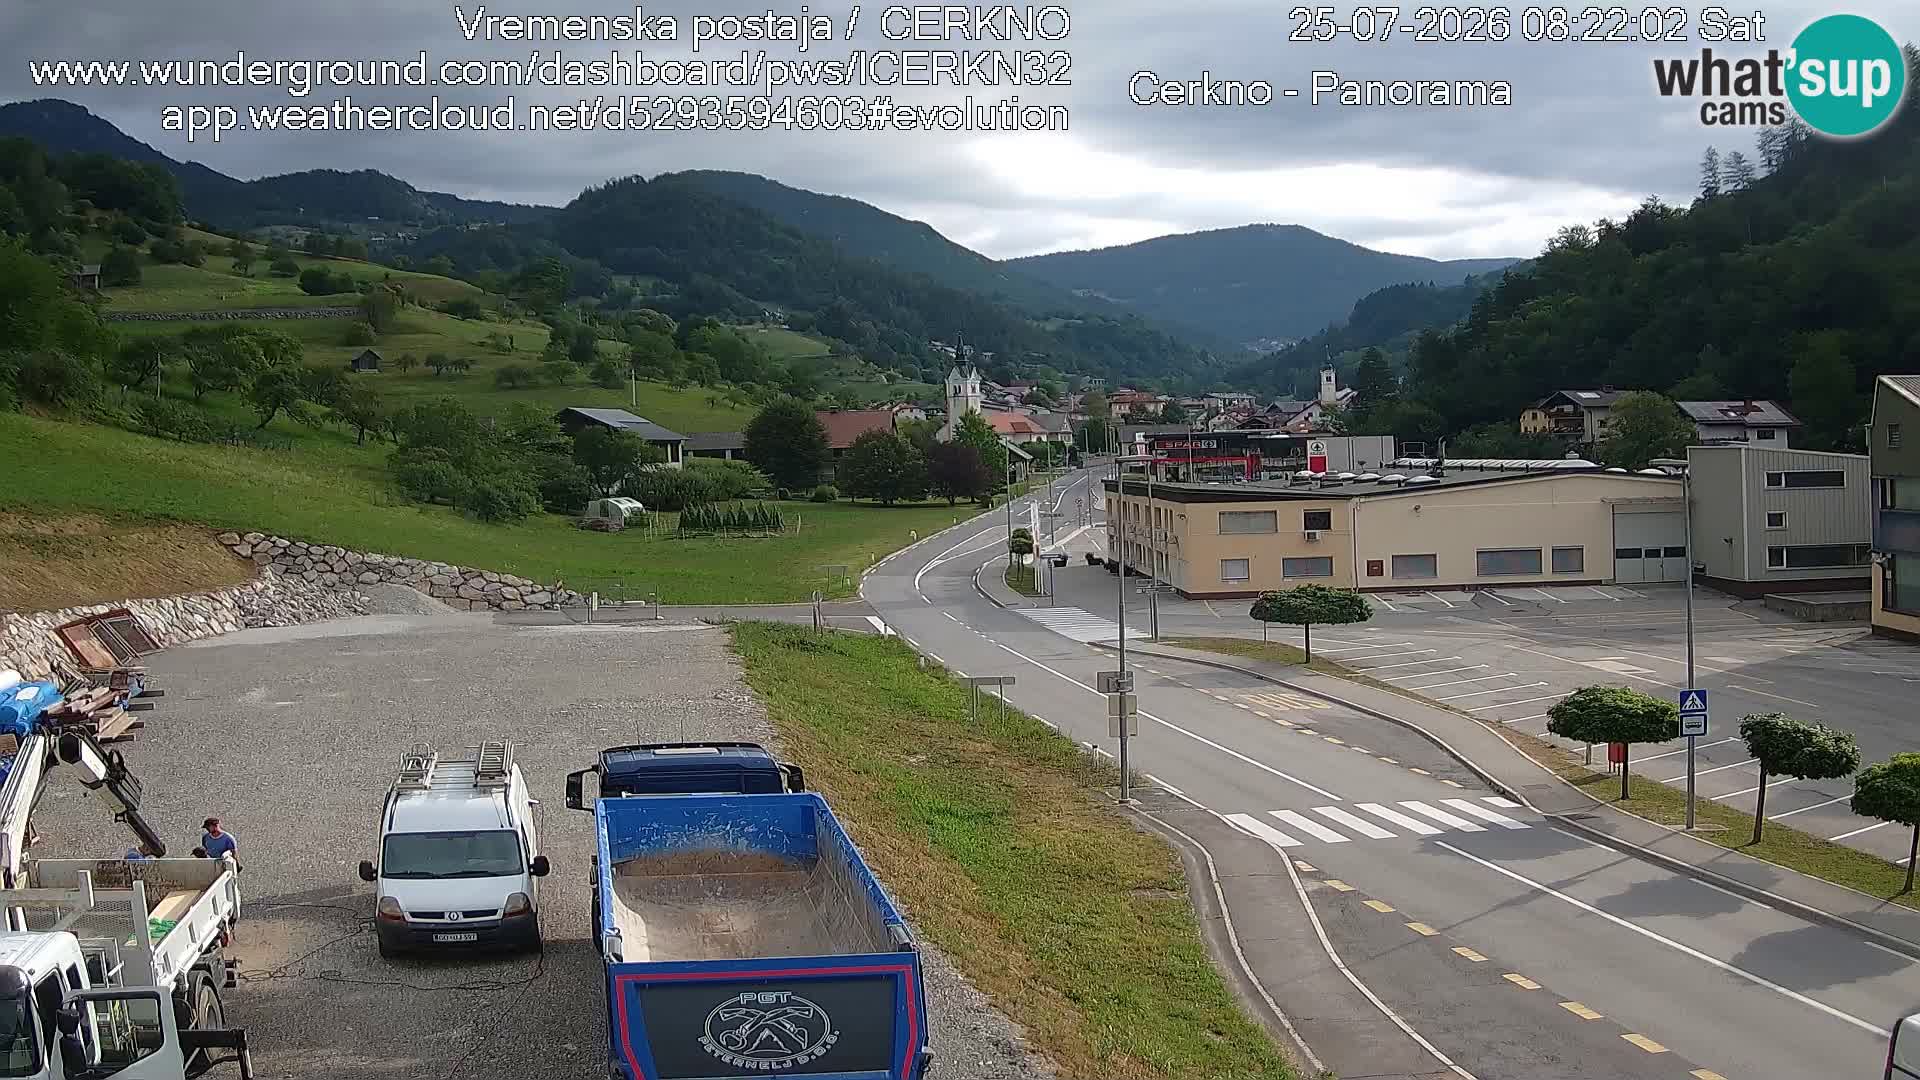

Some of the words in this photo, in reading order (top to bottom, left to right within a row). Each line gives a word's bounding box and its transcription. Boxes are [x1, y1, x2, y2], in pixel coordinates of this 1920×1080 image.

[1238, 693, 1332, 711] BUS
[739, 991, 792, 1005] PGT
[698, 1036, 793, 1070] PETERNELJ
